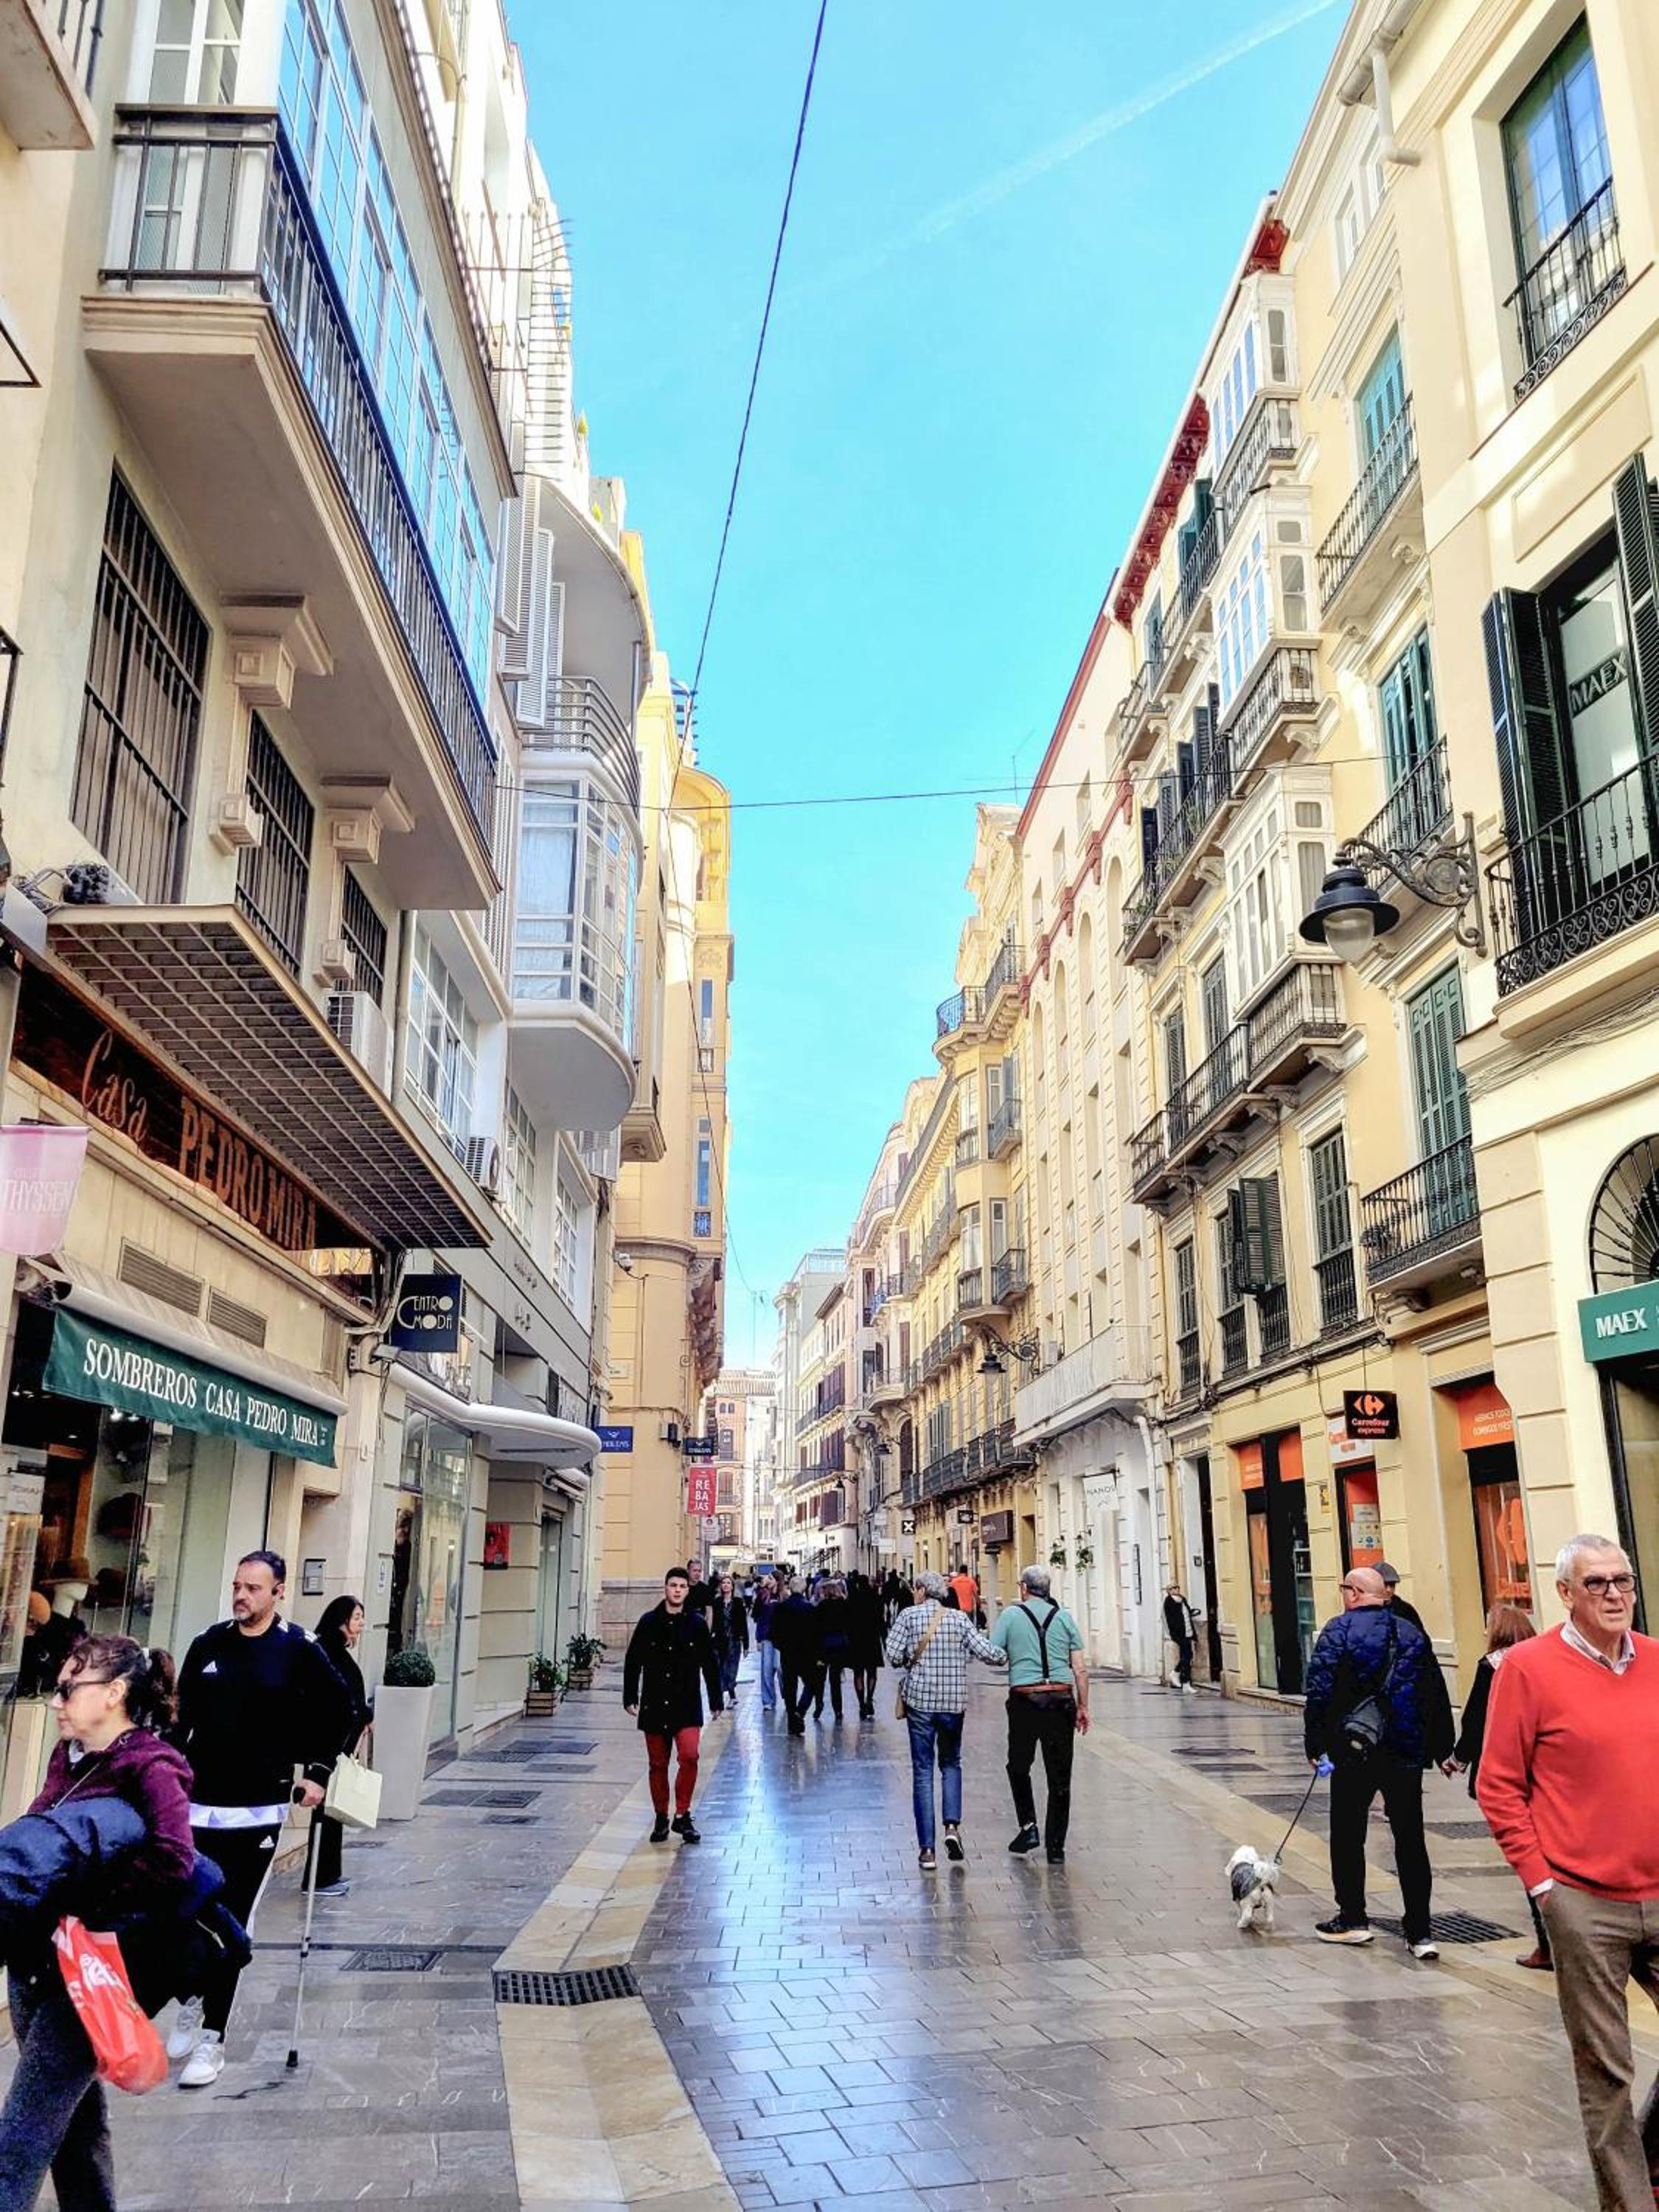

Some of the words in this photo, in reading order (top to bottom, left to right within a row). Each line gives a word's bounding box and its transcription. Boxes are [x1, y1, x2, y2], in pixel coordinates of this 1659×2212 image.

[1571, 651, 1628, 712] MAEX
[82, 1029, 147, 1142] Casa
[178, 1096, 264, 1226] PEDRO
[266, 1164, 316, 1251] MIRA
[1595, 1307, 1648, 1338] MAEX
[83, 1338, 198, 1408] SOMBREROS
[206, 1383, 240, 1422] CASA
[246, 1397, 287, 1436] PEDRO
[291, 1414, 318, 1446] MIRA
[1352, 1418, 1390, 1427] Carrefour
[695, 1480, 710, 1490] RE
[695, 1491, 709, 1500] BA
[694, 1503, 709, 1511] JAS
